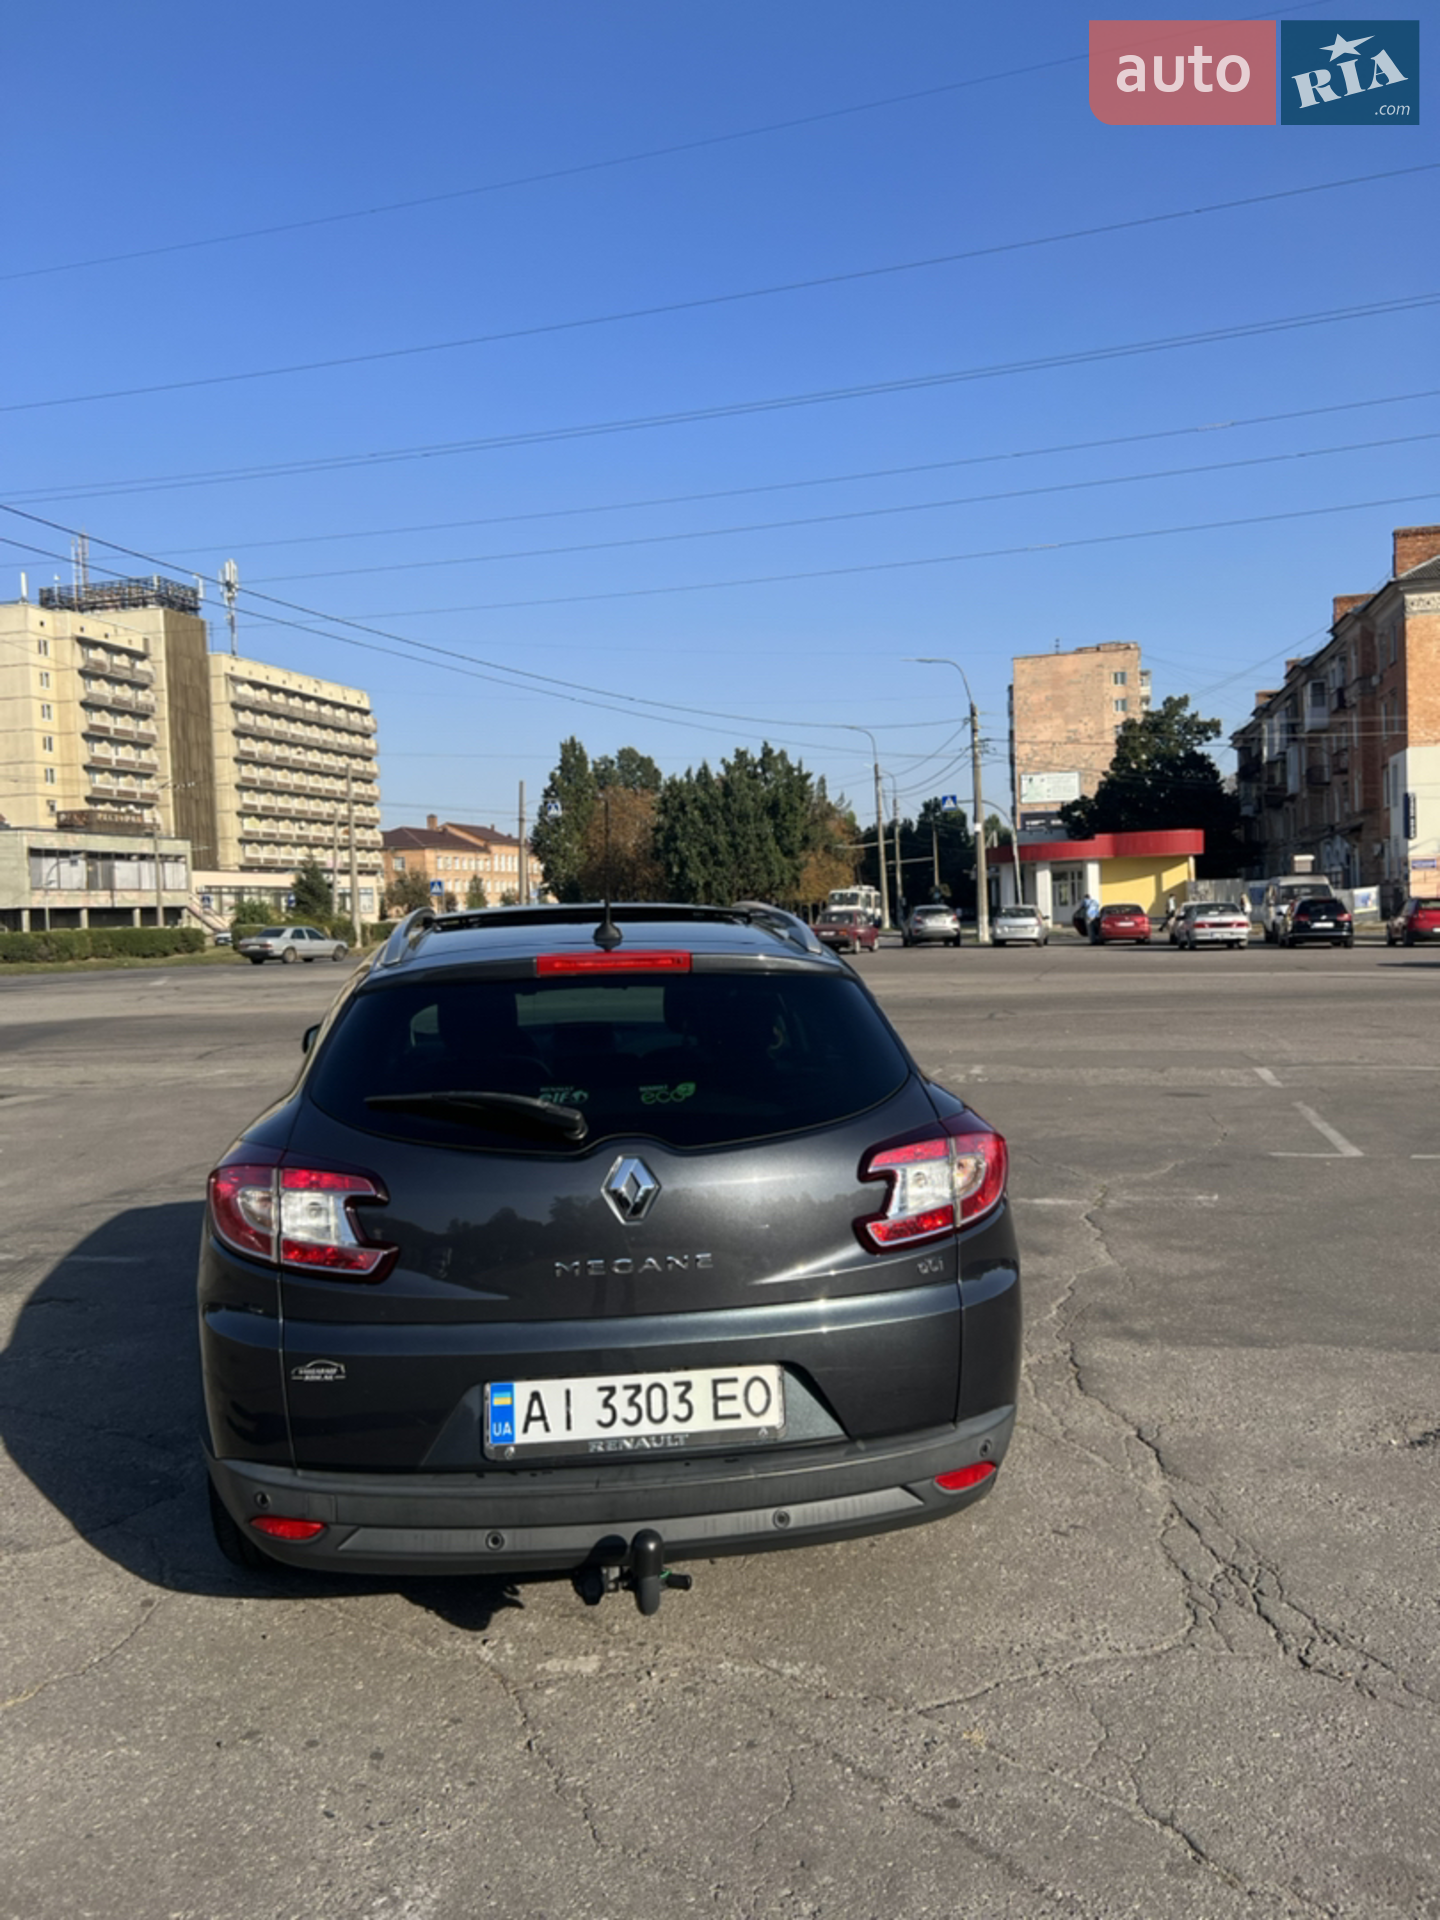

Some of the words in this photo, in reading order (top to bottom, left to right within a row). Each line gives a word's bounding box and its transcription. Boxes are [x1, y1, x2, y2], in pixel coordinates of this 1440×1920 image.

[554, 1252, 713, 1278] MEGANE
[522, 1387, 573, 1434] AI
[596, 1380, 694, 1428] 3303
[711, 1375, 772, 1421] EO
[493, 1421, 512, 1437] UA
[588, 1434, 689, 1453] RENAULT
